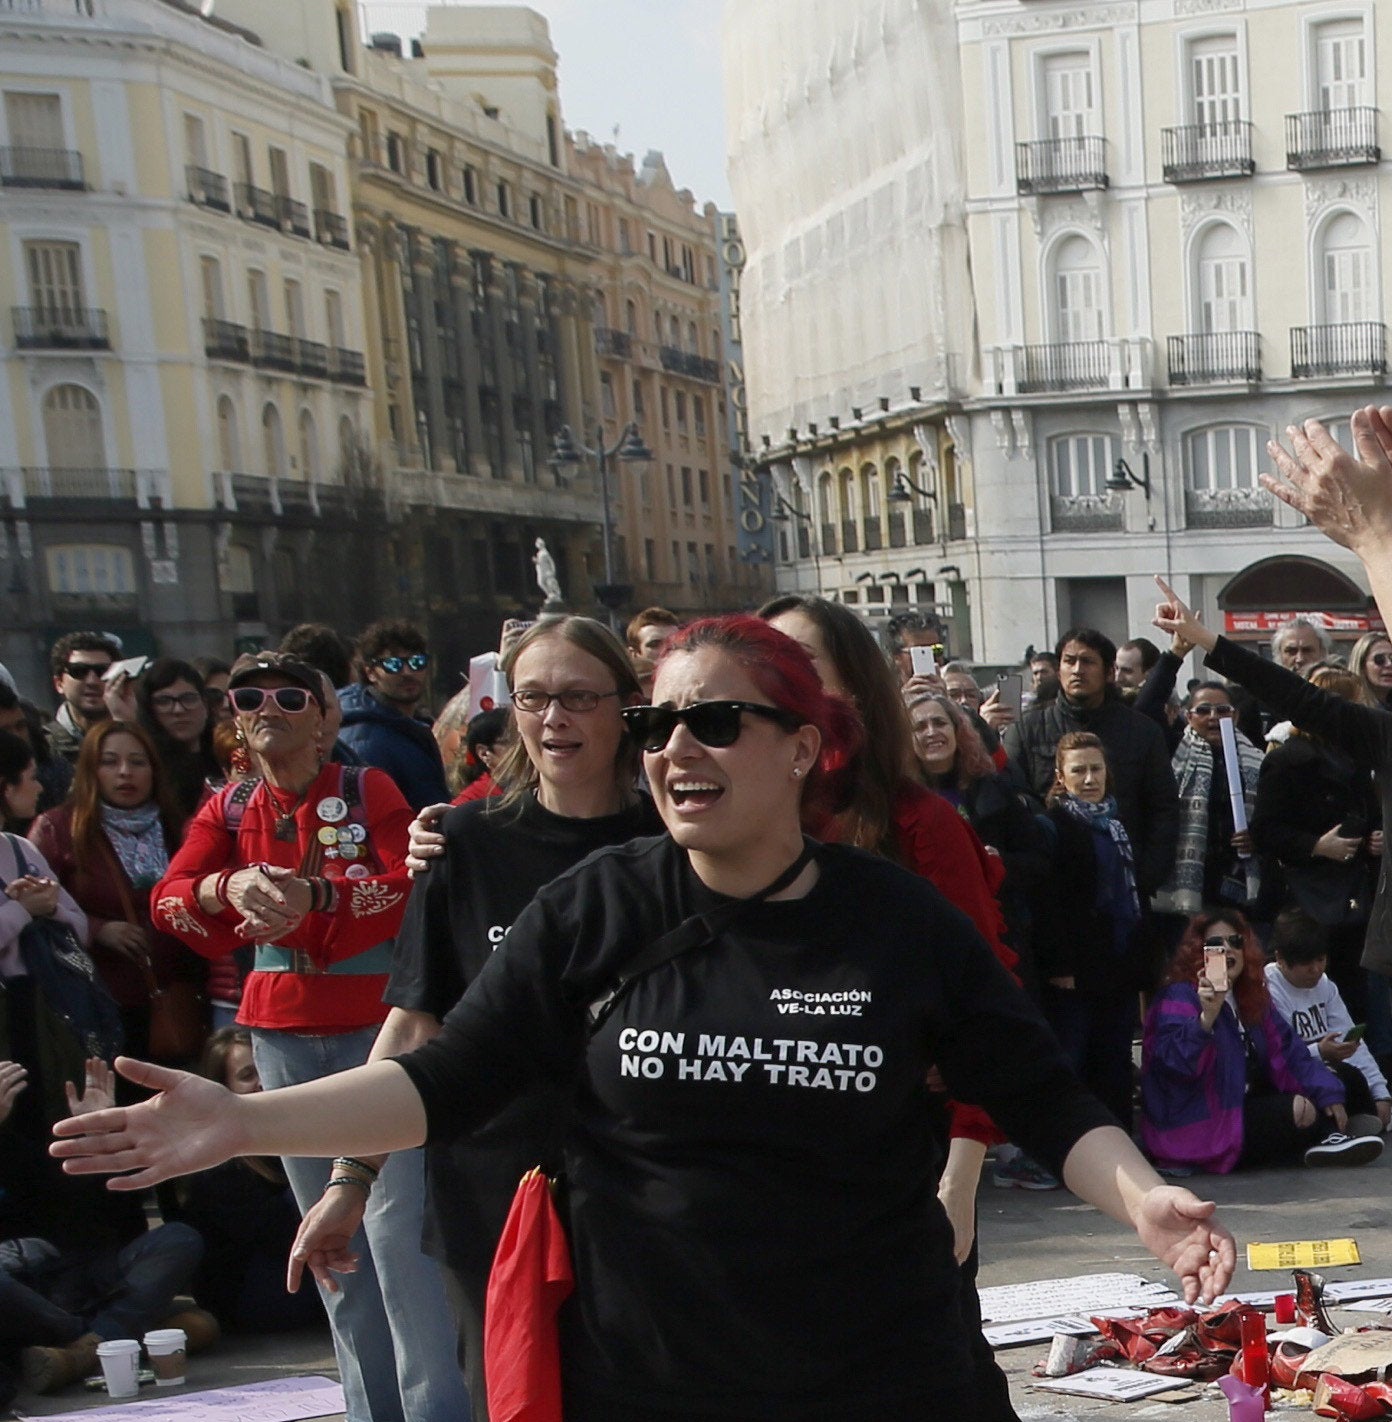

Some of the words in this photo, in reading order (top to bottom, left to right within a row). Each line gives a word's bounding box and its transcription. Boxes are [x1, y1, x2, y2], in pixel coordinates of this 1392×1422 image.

[769, 988, 872, 1002] ASOCIACIÓN
[777, 1002, 826, 1015] VE-LA
[830, 1004, 862, 1016] LUZ
[618, 1028, 685, 1054] CON
[698, 1034, 883, 1068] MALTRATO
[621, 1054, 664, 1079] NO
[678, 1059, 751, 1081] HAY
[764, 1063, 877, 1092] TRATO
